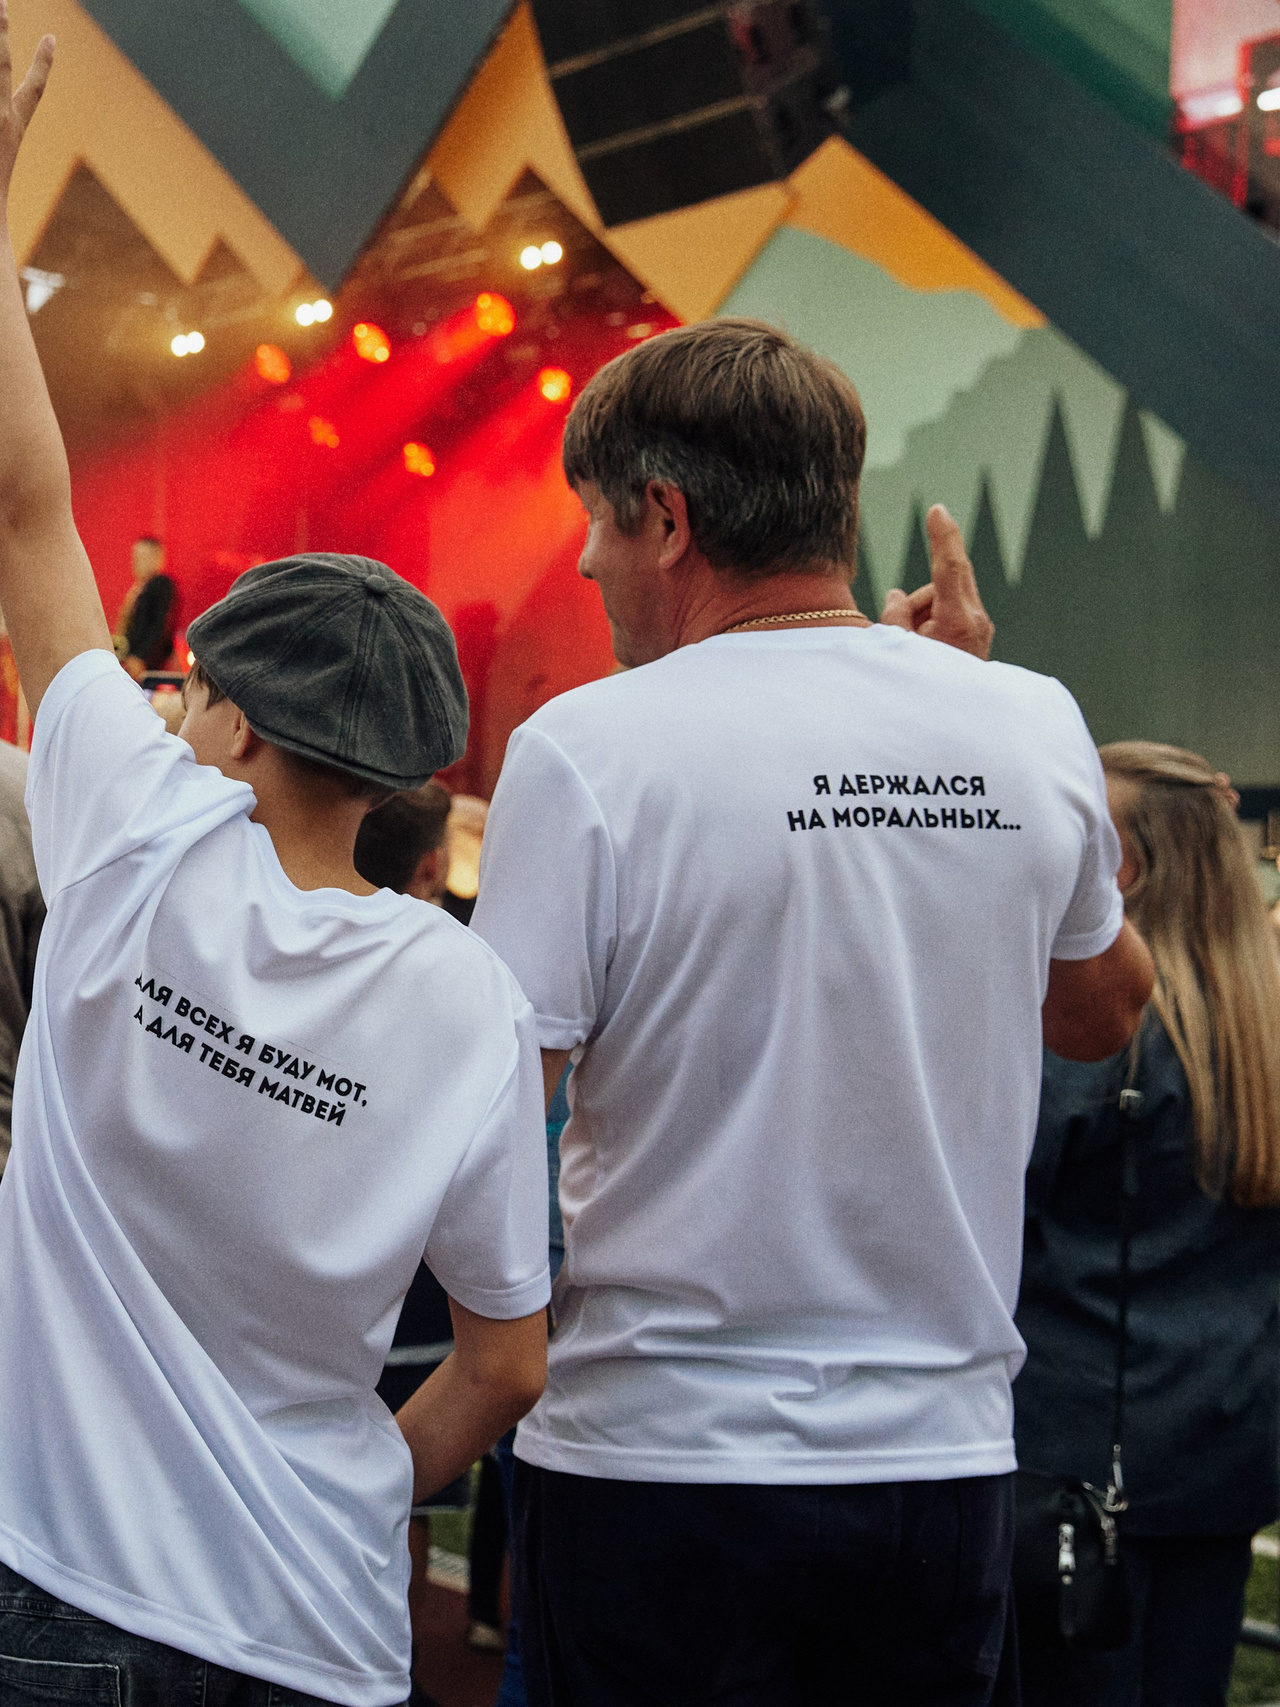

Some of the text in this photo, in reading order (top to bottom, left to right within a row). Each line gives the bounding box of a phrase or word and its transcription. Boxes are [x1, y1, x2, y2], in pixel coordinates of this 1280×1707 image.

[813, 774, 986, 796] Я ДЕРЖАЛСЯ
[787, 808, 826, 832] НА
[145, 1016, 196, 1054] ДЛЯ
[198, 1042, 256, 1088] ТЕБЯ
[257, 1076, 347, 1127] МАТВЕЙ
[174, 996, 235, 1044] ВСЕХ
[234, 1034, 256, 1055] Я
[258, 1043, 316, 1080] БУДУ
[316, 1068, 368, 1107] МОТ,
